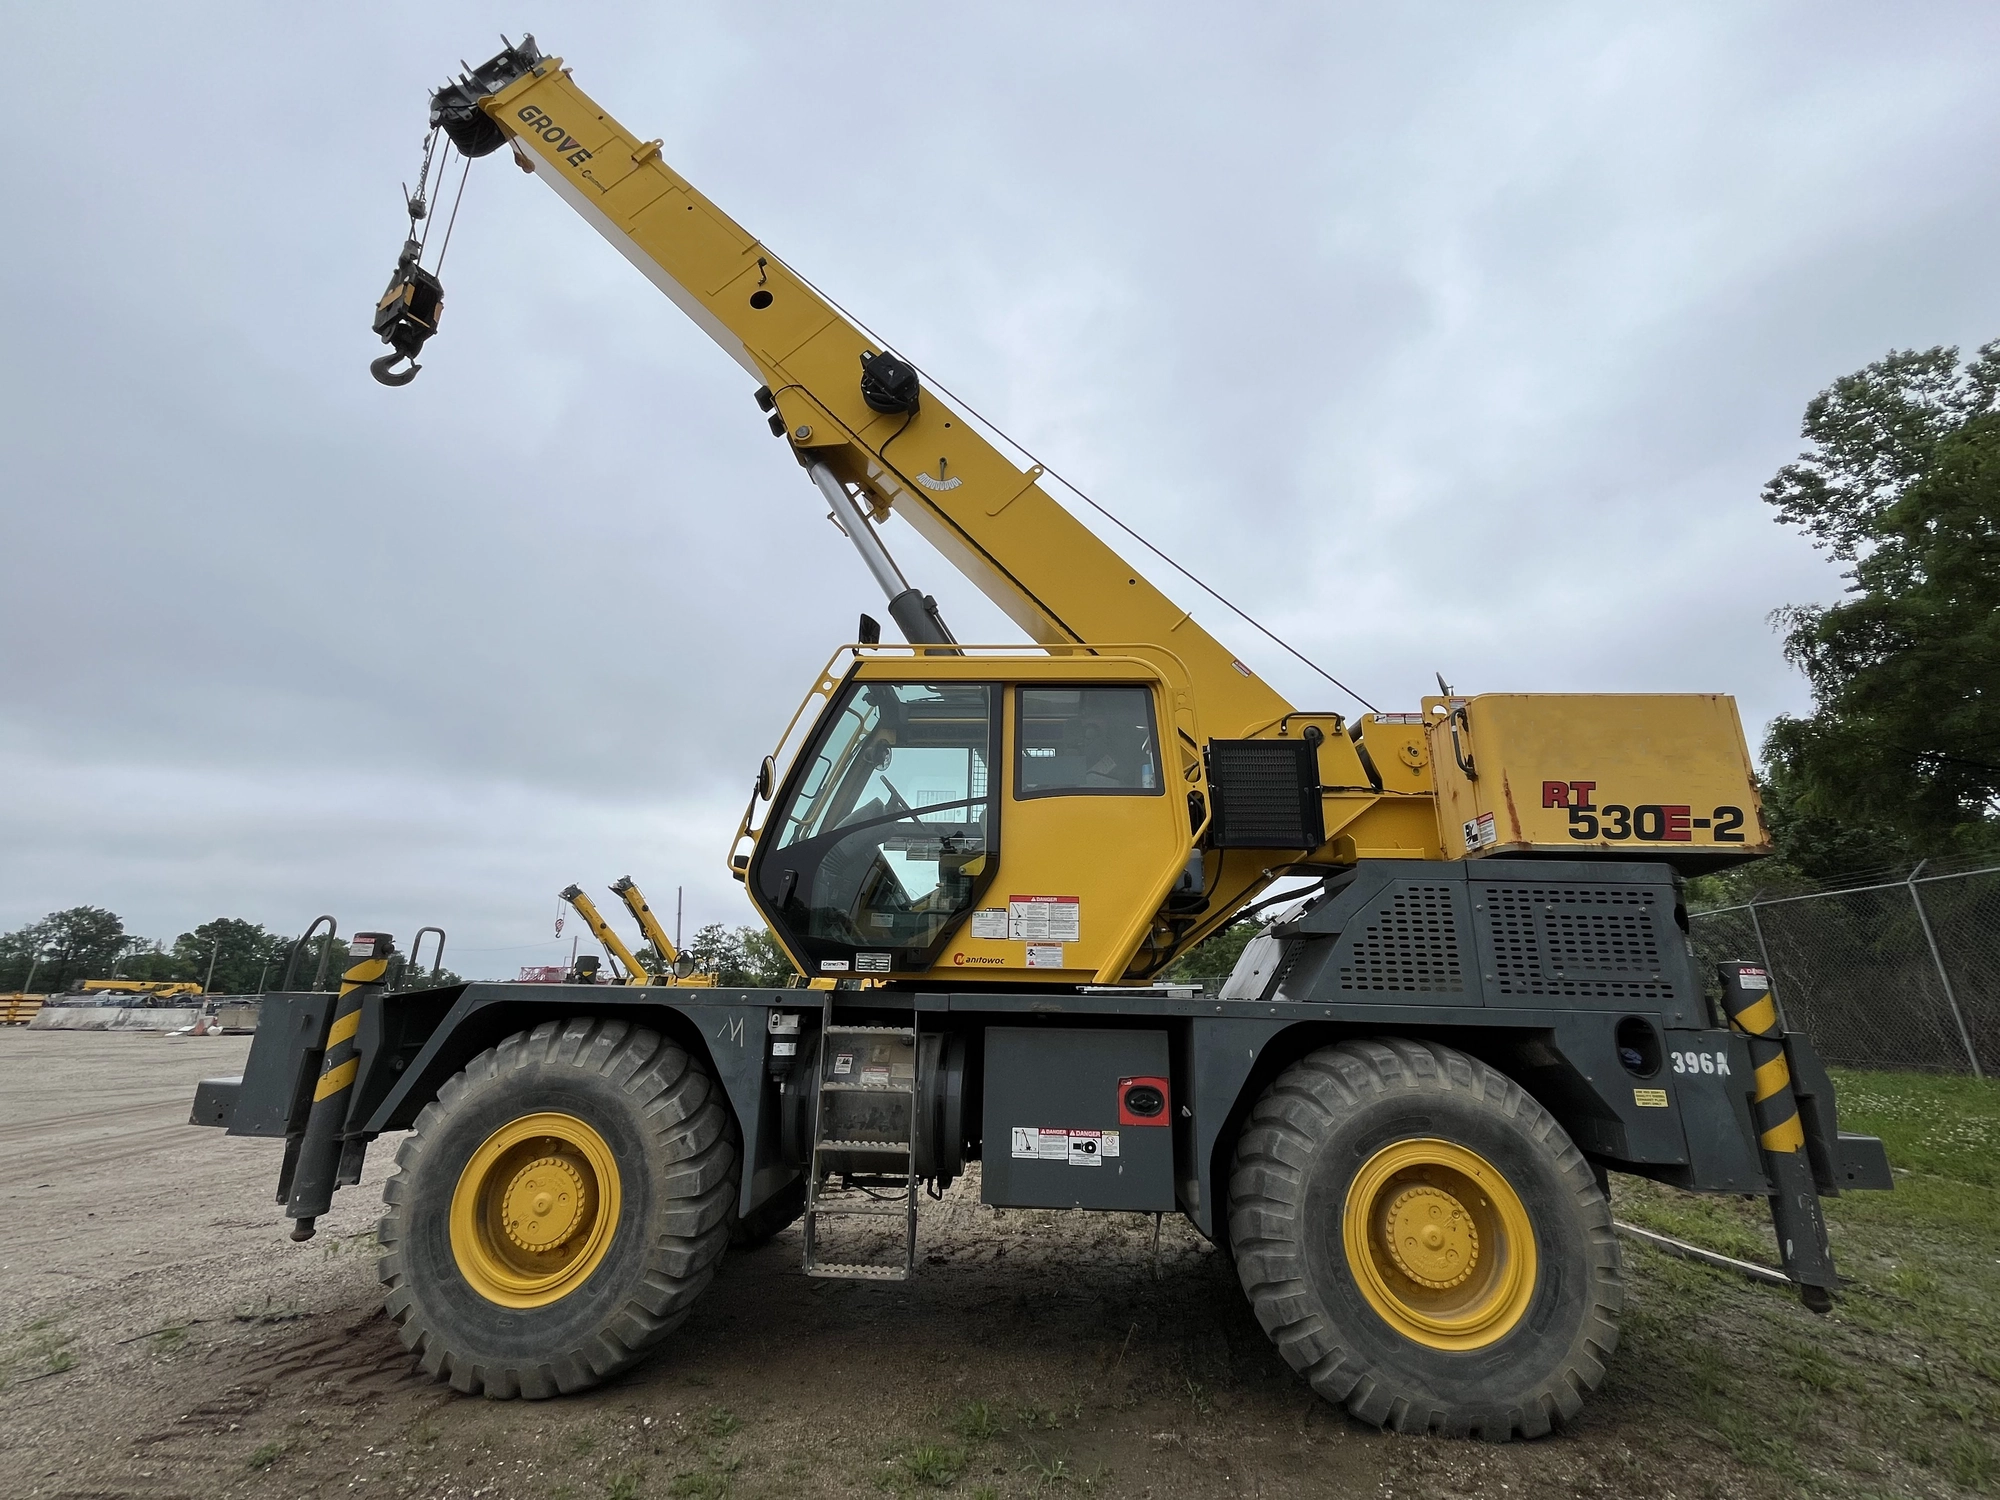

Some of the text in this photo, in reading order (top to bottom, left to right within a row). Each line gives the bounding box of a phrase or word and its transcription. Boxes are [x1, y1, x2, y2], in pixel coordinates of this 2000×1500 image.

[517, 105, 593, 167] GROVE
[1542, 781, 1596, 808] RT
[1568, 804, 1745, 842] 530E-2
[1671, 1051, 1731, 1075] 396A
